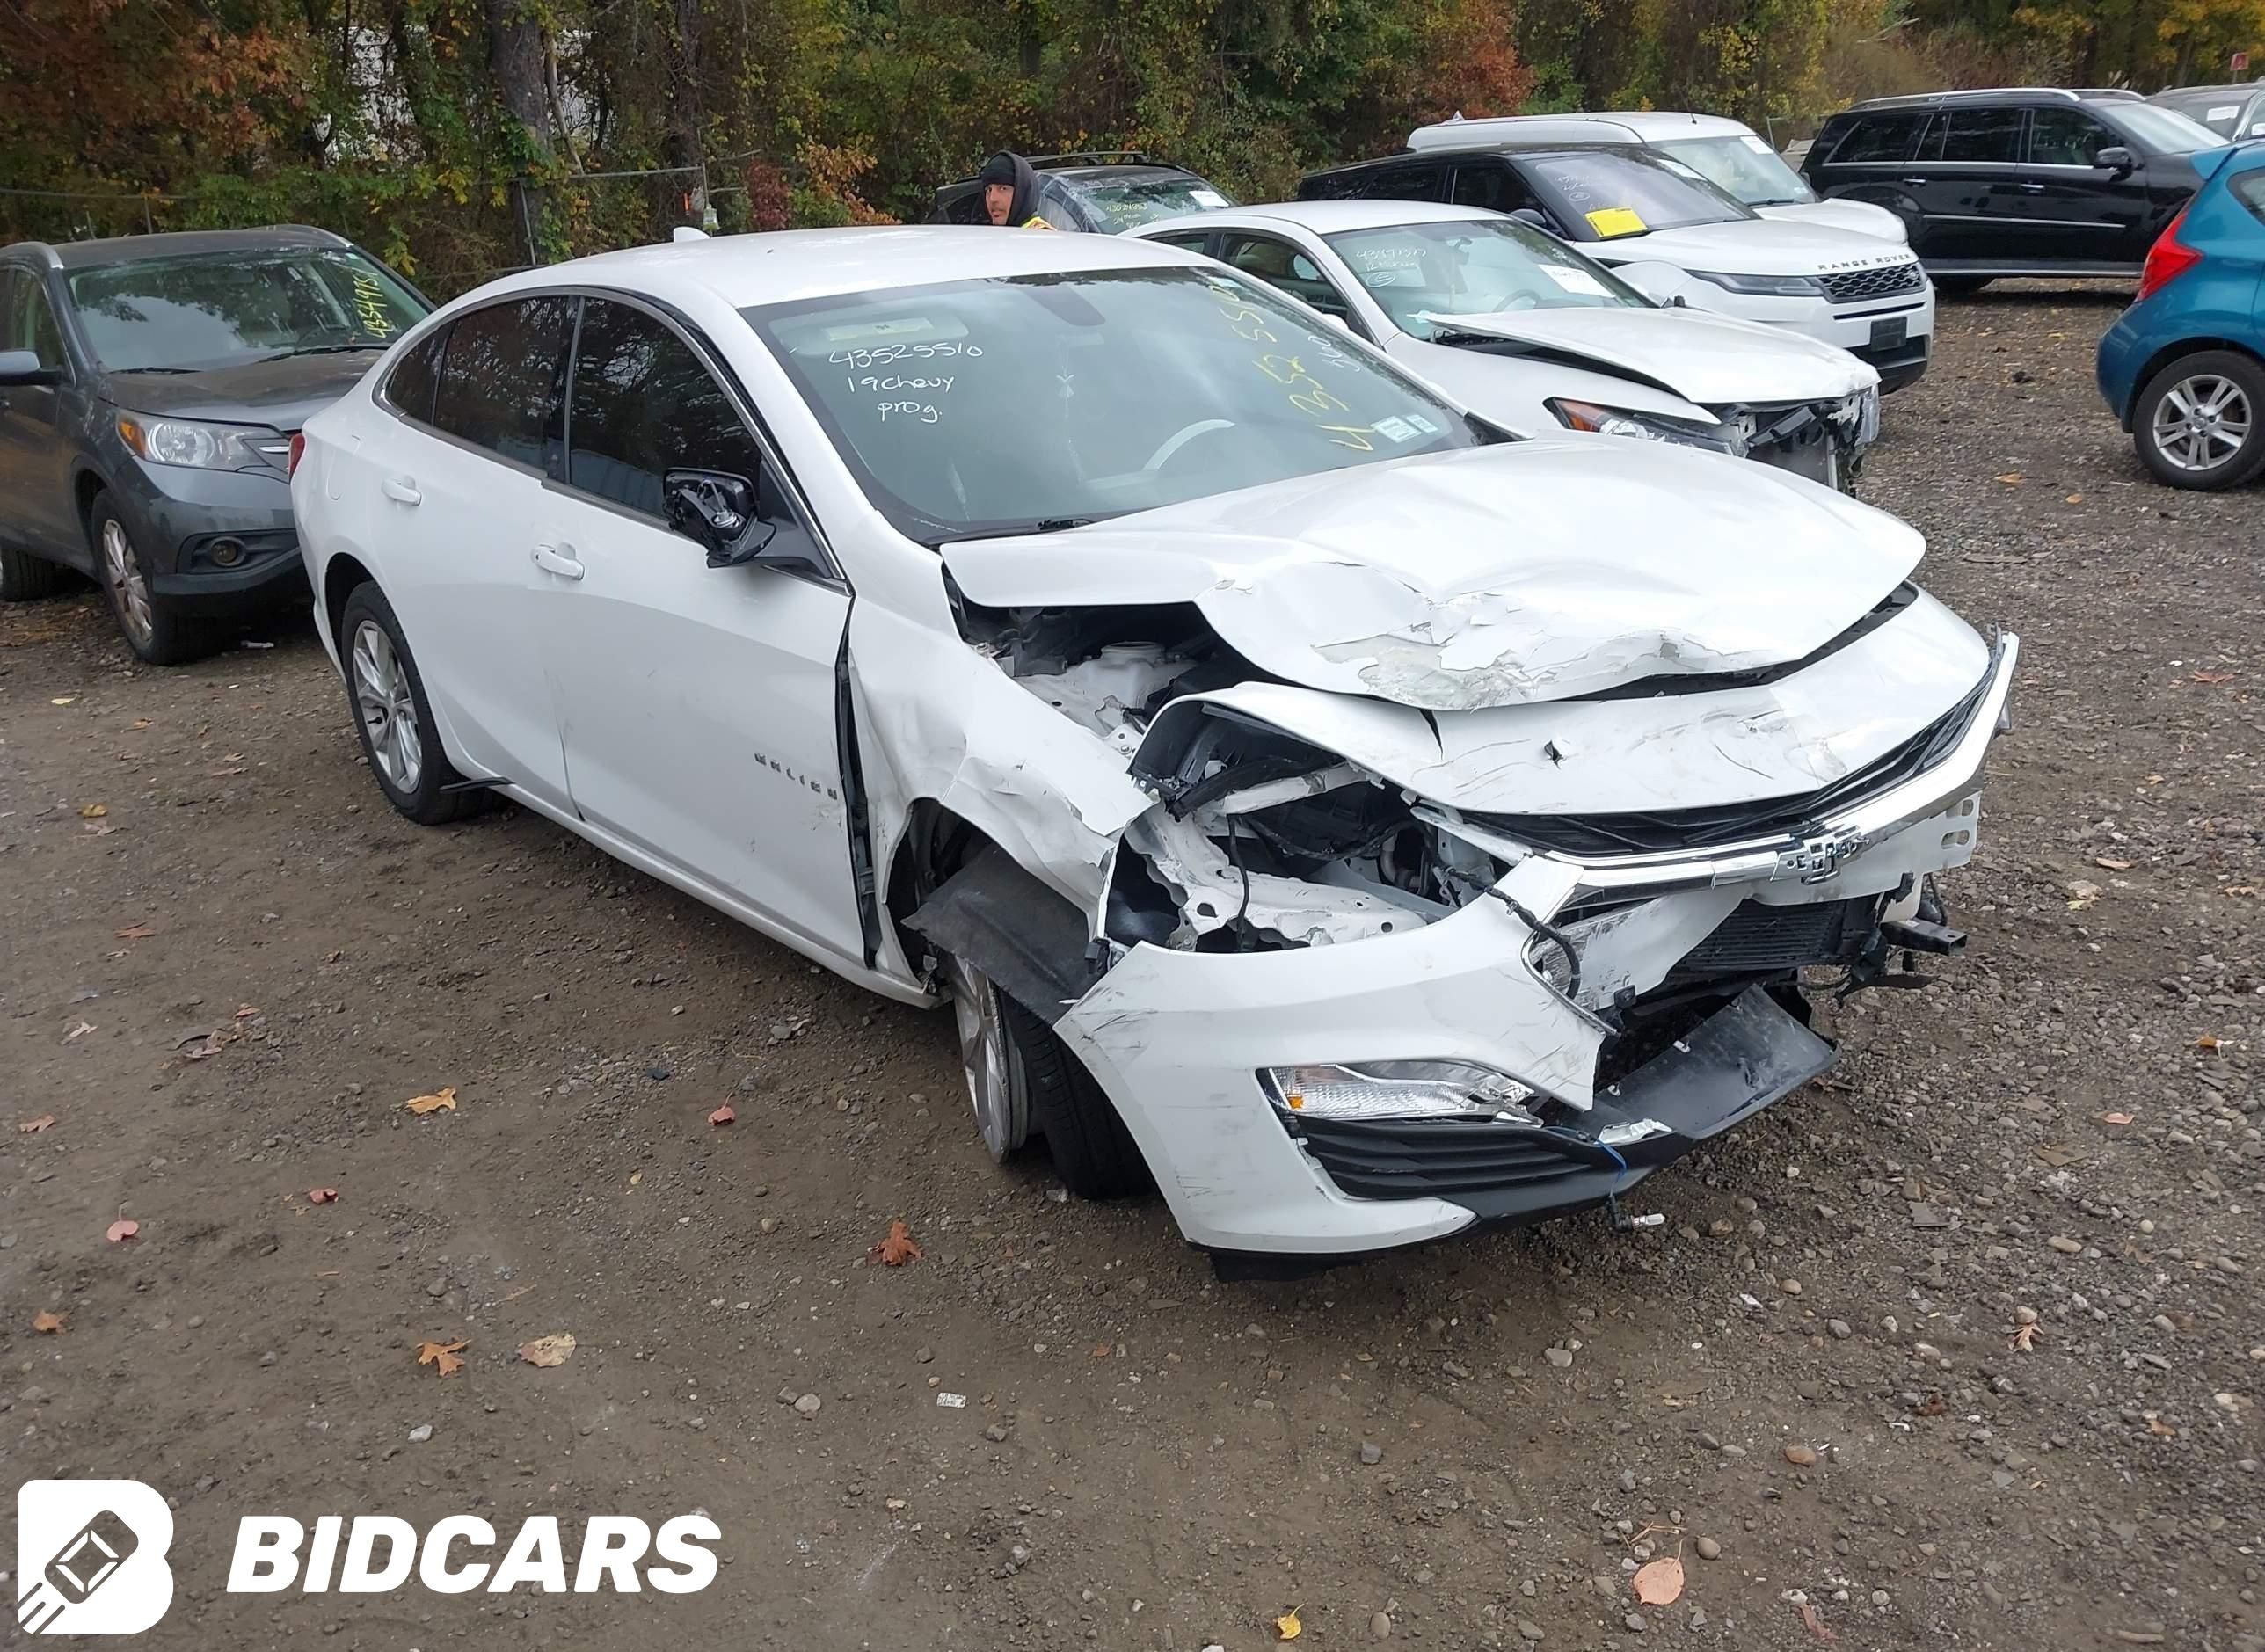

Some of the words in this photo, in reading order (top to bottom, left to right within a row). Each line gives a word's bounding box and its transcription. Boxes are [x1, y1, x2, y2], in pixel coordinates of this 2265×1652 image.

[1817, 258, 1868, 271] RANGE
[1875, 253, 1911, 264] ROVER
[828, 342, 984, 369] 43525510
